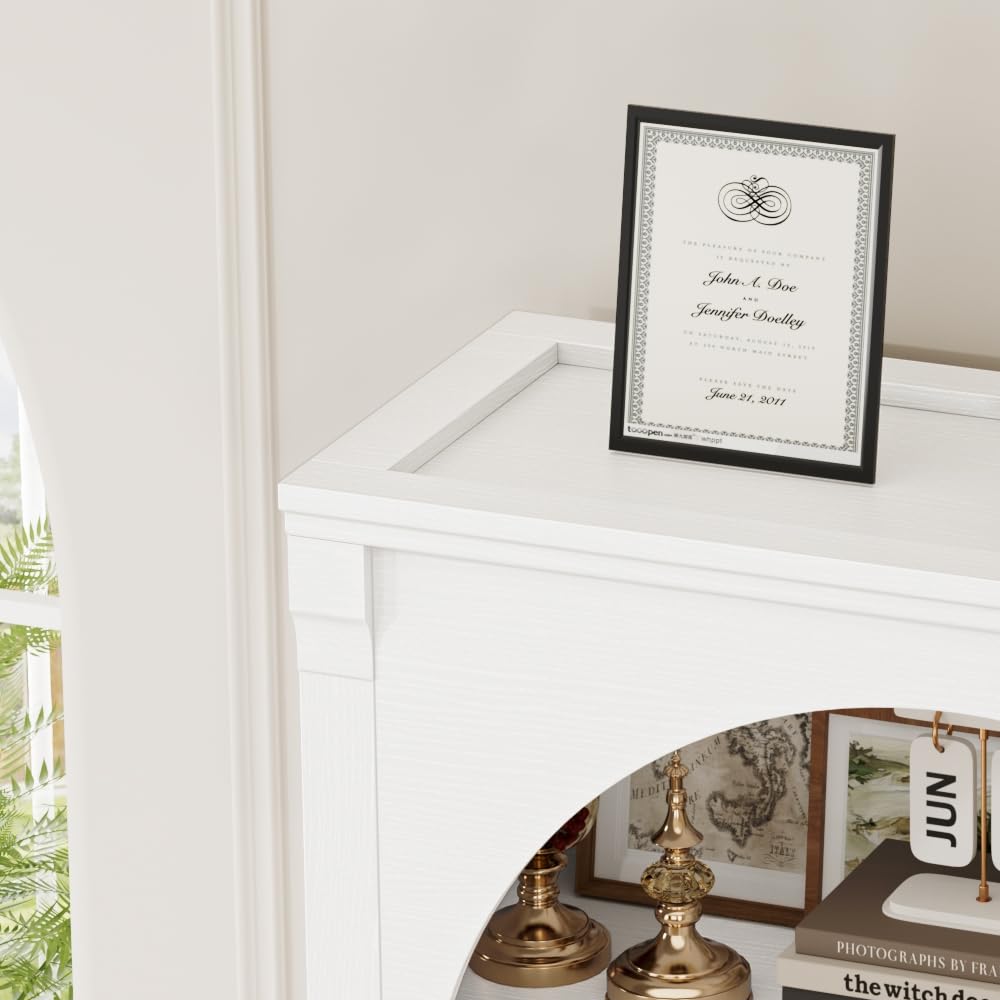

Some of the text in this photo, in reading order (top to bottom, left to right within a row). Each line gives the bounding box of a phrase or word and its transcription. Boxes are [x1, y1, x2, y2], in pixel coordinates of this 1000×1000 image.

[703, 271, 799, 293] John A. Doe
[691, 302, 806, 330] Jennifer Doelley
[705, 387, 787, 406] June 21, 2011
[926, 771, 957, 848] JUN
[836, 940, 946, 970] PHOTOGRAPHS
[950, 957, 968, 972] BY
[843, 973, 882, 997] the
